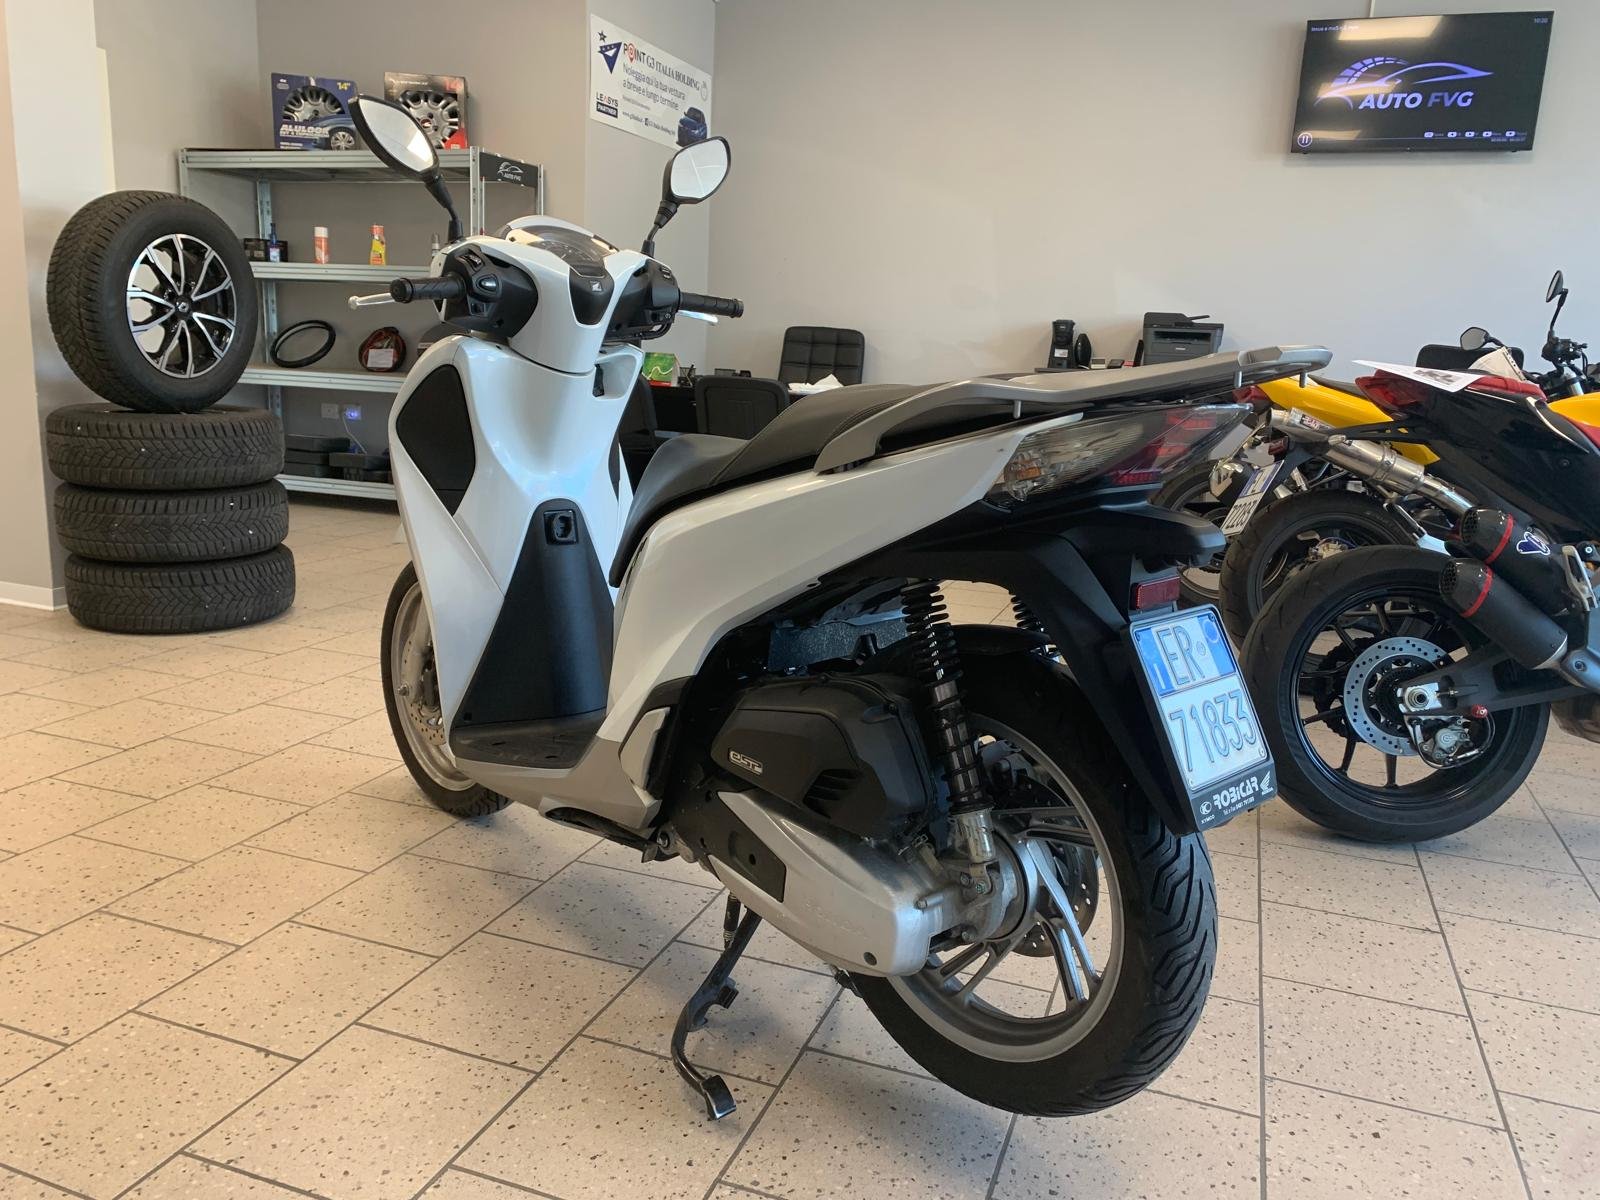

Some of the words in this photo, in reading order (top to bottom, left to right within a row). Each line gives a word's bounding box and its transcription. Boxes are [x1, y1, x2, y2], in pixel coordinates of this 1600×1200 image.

[623, 43, 646, 63] POINT
[656, 60, 675, 79] ITALIA
[596, 91, 619, 107] LEASYS
[1359, 92, 1423, 109] AUTO
[1427, 91, 1474, 107] FVG
[1155, 625, 1206, 686] ER
[1169, 689, 1257, 772] 71833
